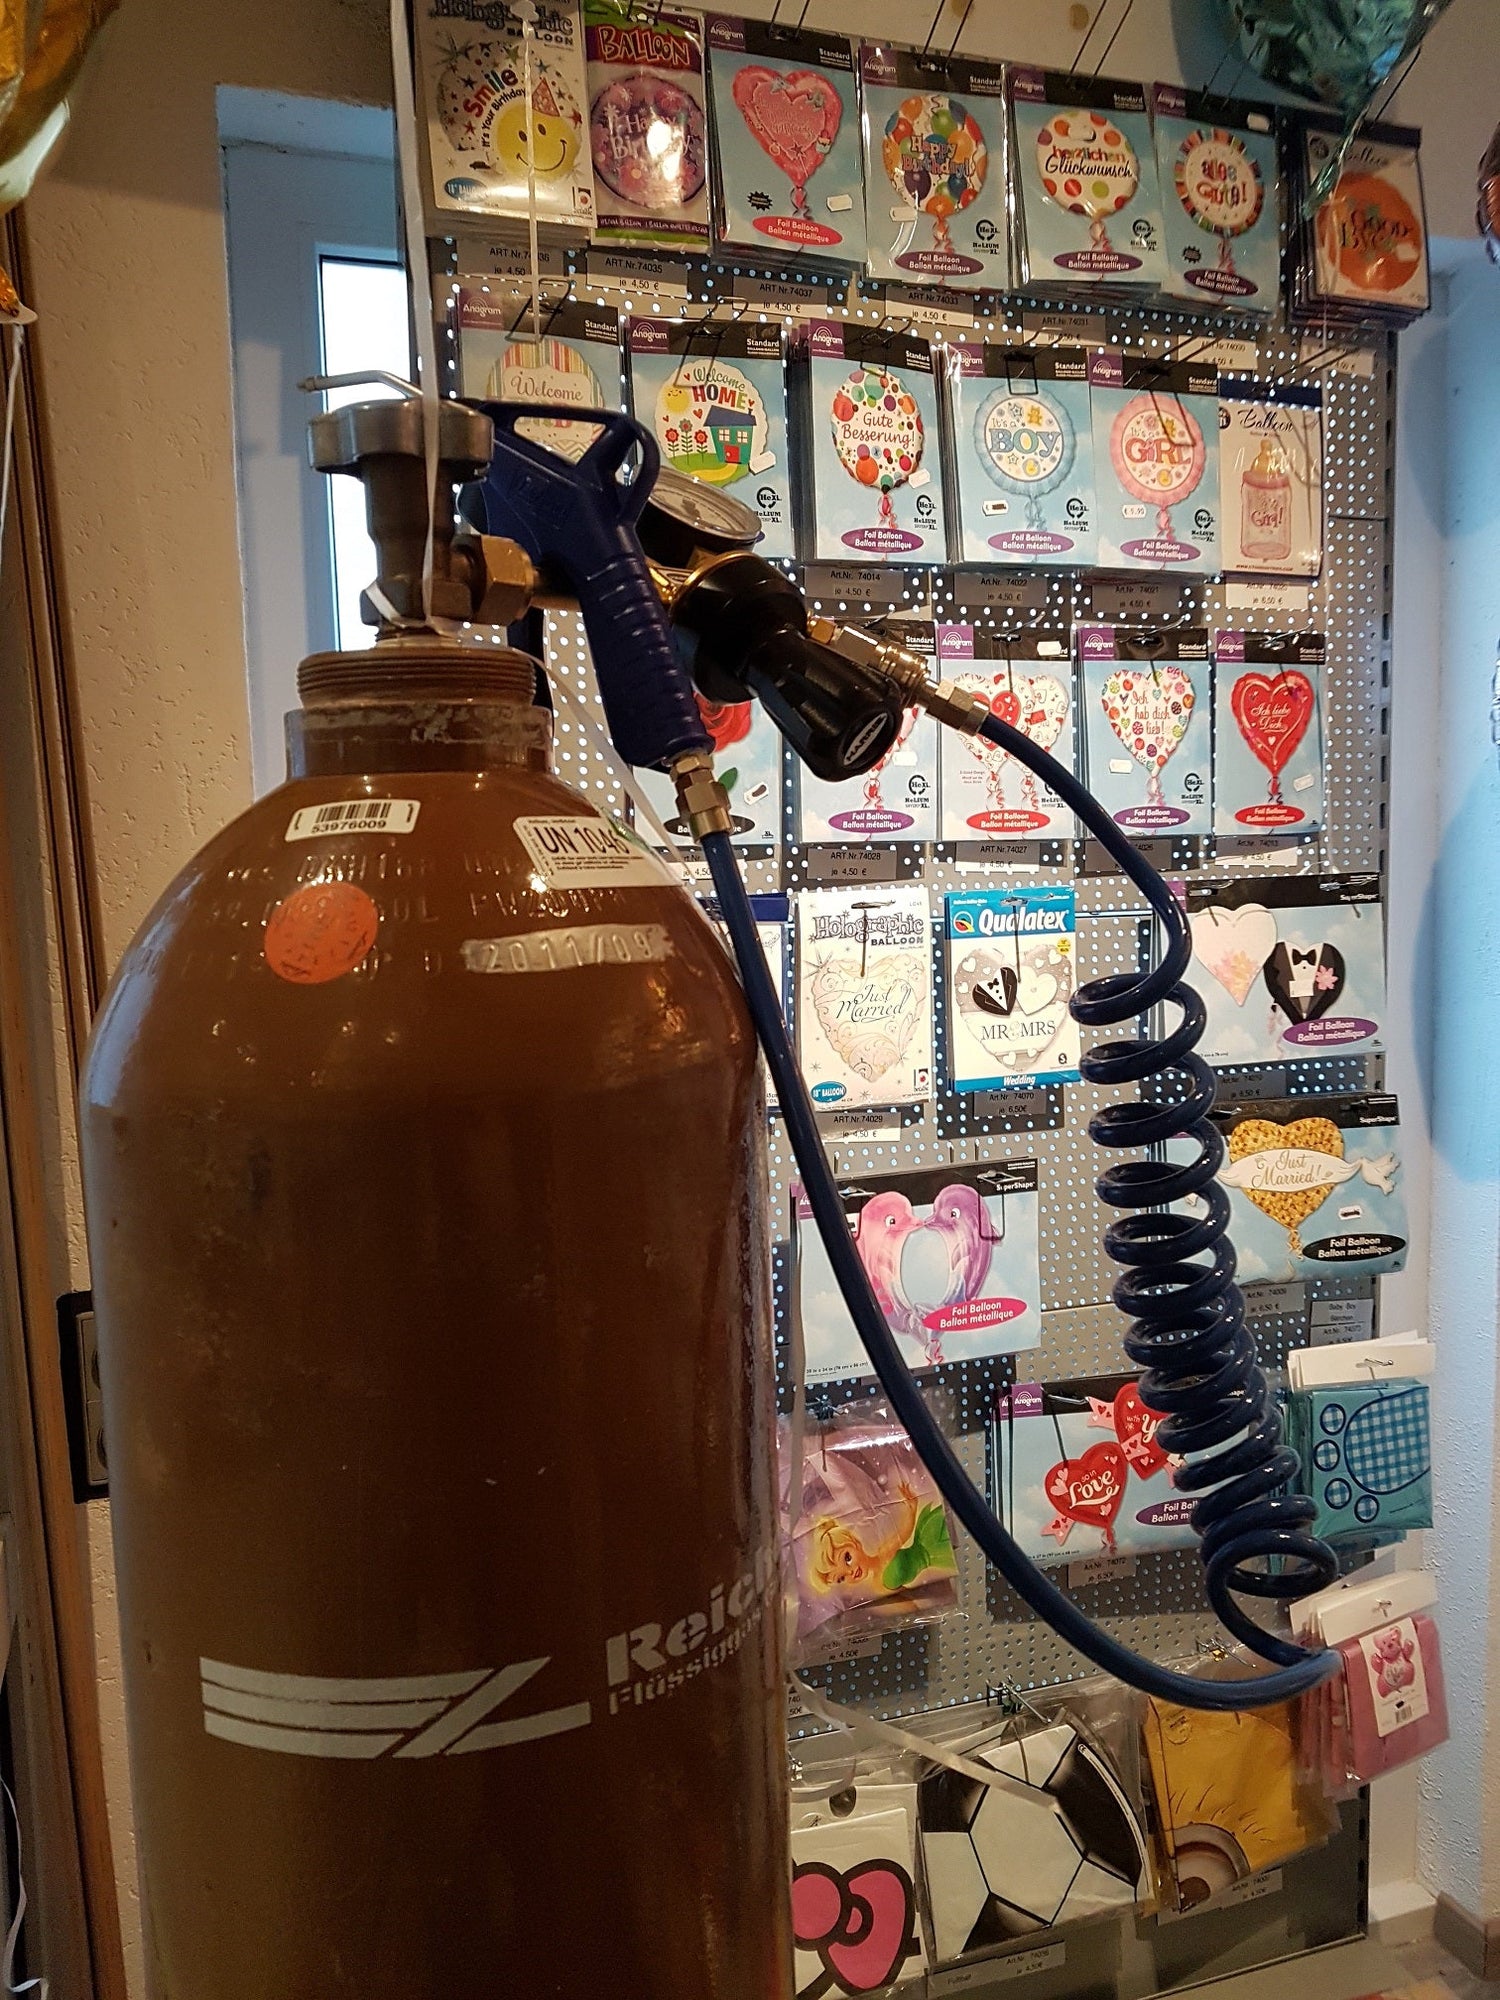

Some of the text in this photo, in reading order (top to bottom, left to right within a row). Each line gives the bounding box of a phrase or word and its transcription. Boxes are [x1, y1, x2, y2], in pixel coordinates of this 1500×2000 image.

[710, 25, 744, 40] Anagram
[600, 26, 690, 65] BALLOON
[819, 48, 850, 60] Standard
[864, 61, 896, 75] Anagram
[970, 76, 1000, 86] Standard
[463, 69, 518, 118] Smile
[482, 109, 495, 130] Your
[491, 88, 526, 111] Birthday
[910, 134, 957, 159] Happy
[1045, 153, 1133, 178] Glückwunsch
[777, 219, 819, 233] Foil Balloon
[768, 226, 829, 243] Ballon métallique
[918, 254, 961, 264] Foil Balloon
[1076, 253, 1119, 262] Foil Balloon
[909, 261, 970, 273] Ballon métallique
[463, 304, 501, 317] Anagram
[585, 320, 617, 334] Standard
[632, 329, 667, 342] Anagram
[812, 333, 843, 346] Anagram
[746, 338, 780, 348] Standard
[905, 350, 930, 362] Standard
[1054, 362, 1086, 371] Standard
[693, 366, 746, 390] Welcome
[1092, 367, 1122, 379] Anagram
[511, 376, 584, 401] Welcome
[692, 384, 748, 410] HOME
[863, 412, 894, 428] Gute
[841, 423, 915, 448] Besserung!
[864, 530, 903, 540] Foil Balloon
[1011, 533, 1052, 542] Foil Balloon
[855, 538, 912, 550] Ballon métallique
[1002, 541, 1062, 551] Ballon métallique
[1142, 542, 1180, 551] Foil Balloon
[1134, 549, 1154, 558] Ballon
[858, 572, 880, 582] 74014
[845, 587, 862, 596] 4,50
[905, 635, 934, 644] Standard
[942, 639, 972, 650] Anagram
[1084, 642, 1114, 652] Anagram
[1131, 691, 1148, 705] Ich
[1135, 706, 1170, 720] hab dich
[1146, 721, 1165, 735] lieb!
[852, 812, 892, 821] Foil Balloon
[311, 820, 387, 834] 53976009
[843, 820, 902, 830] Ballon métallique
[1003, 820, 1039, 829] métallique
[534, 826, 630, 855] UN 1046
[842, 867, 858, 876] 4,50
[1340, 893, 1378, 902] SuperShape
[813, 912, 924, 943] Holographic
[979, 907, 1067, 936] Qualatex
[871, 936, 924, 946] BALLOON
[483, 931, 651, 973] 2011/09
[854, 984, 892, 1004] Just
[836, 985, 912, 1023] Married
[981, 1024, 1010, 1041] MR
[1020, 1020, 1056, 1038] MRS
[1308, 1020, 1355, 1031] Foil Balloon
[1298, 1032, 1325, 1042] Ballon
[1003, 1075, 1036, 1086] Wedding
[822, 1086, 845, 1097] BALLOON
[1275, 1151, 1313, 1171] Just
[1251, 1164, 1322, 1188] Married!
[1330, 1237, 1381, 1248] Foil Balloon
[1318, 1246, 1393, 1258] Ballon métallique
[952, 1301, 1002, 1317] Foil Balloon
[940, 1310, 1014, 1329] Ballon métallique
[1014, 1397, 1042, 1407] Anagram
[1068, 1470, 1120, 1510] Love
[1163, 1503, 1179, 1512] Foil
[1151, 1513, 1179, 1523] Ballon
